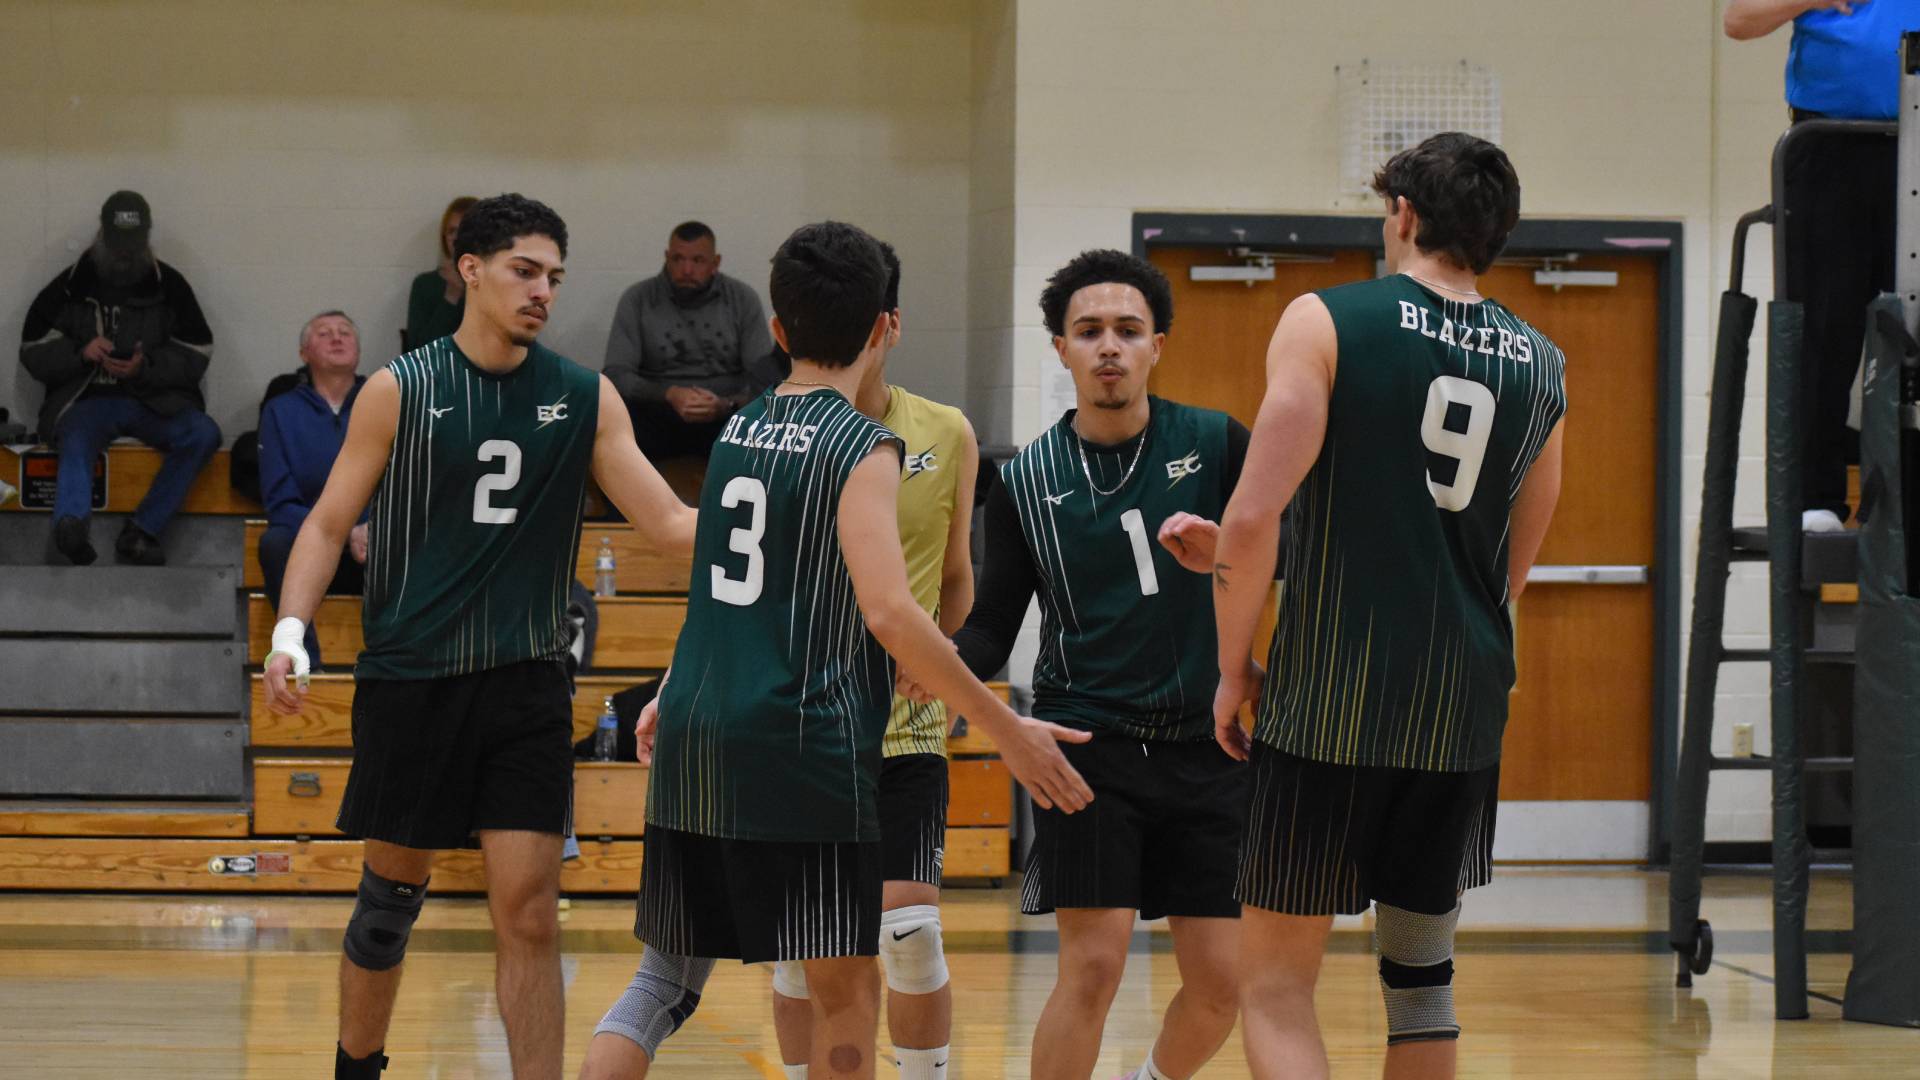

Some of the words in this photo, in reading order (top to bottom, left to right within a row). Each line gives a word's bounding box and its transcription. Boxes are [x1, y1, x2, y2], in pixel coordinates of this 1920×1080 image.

[1399, 300, 1531, 363] BLAZERS
[720, 414, 817, 453] BLAZERS
[1421, 375, 1496, 512] 9
[473, 439, 522, 524] 2
[711, 476, 767, 606] 3
[1120, 508, 1159, 596] 1
